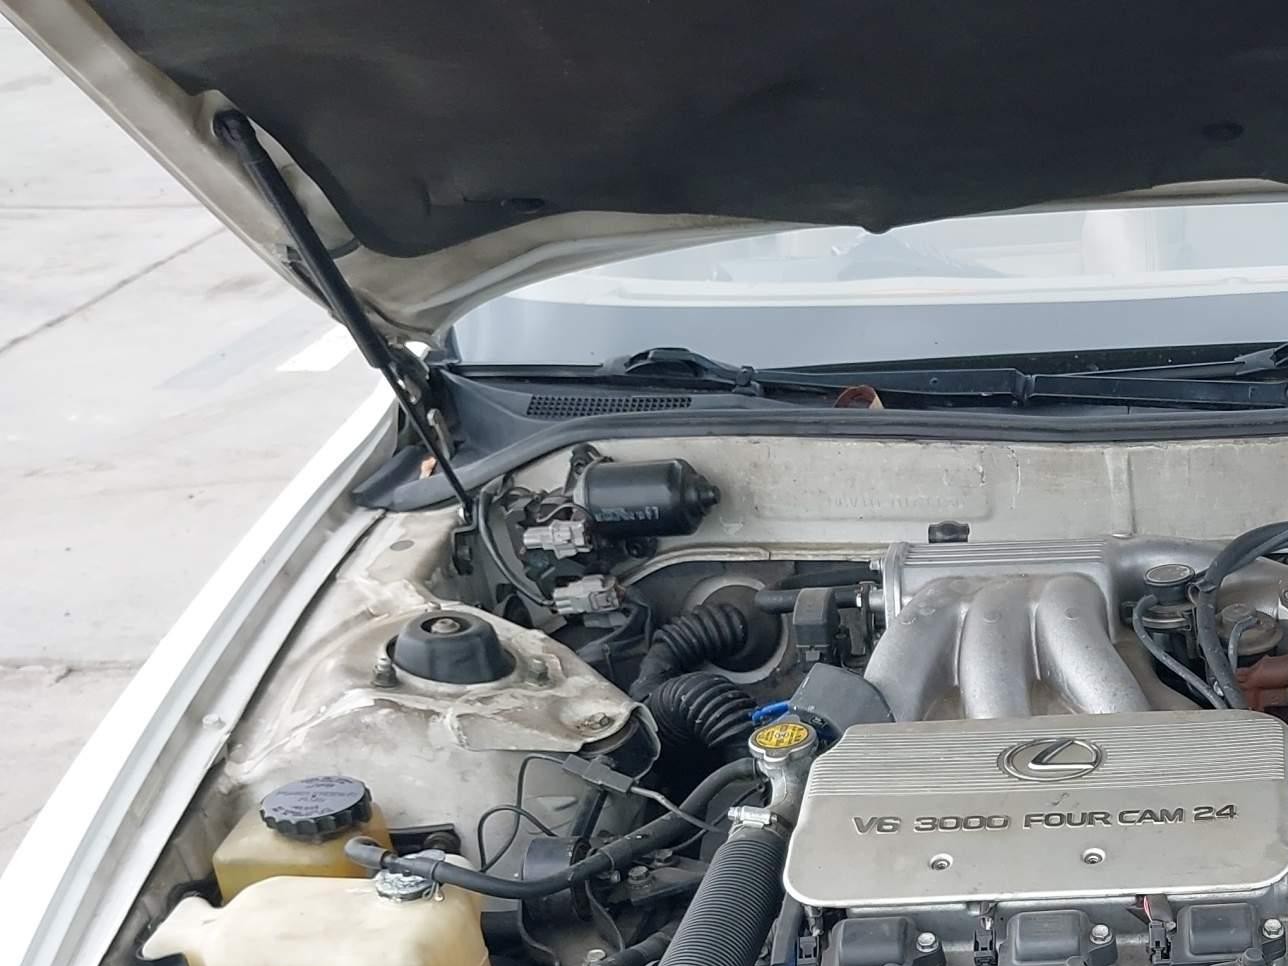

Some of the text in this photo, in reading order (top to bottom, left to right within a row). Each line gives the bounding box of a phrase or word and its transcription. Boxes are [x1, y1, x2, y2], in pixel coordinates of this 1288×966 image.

[853, 804, 1238, 835] V6 3000 FOUR CAM 24
